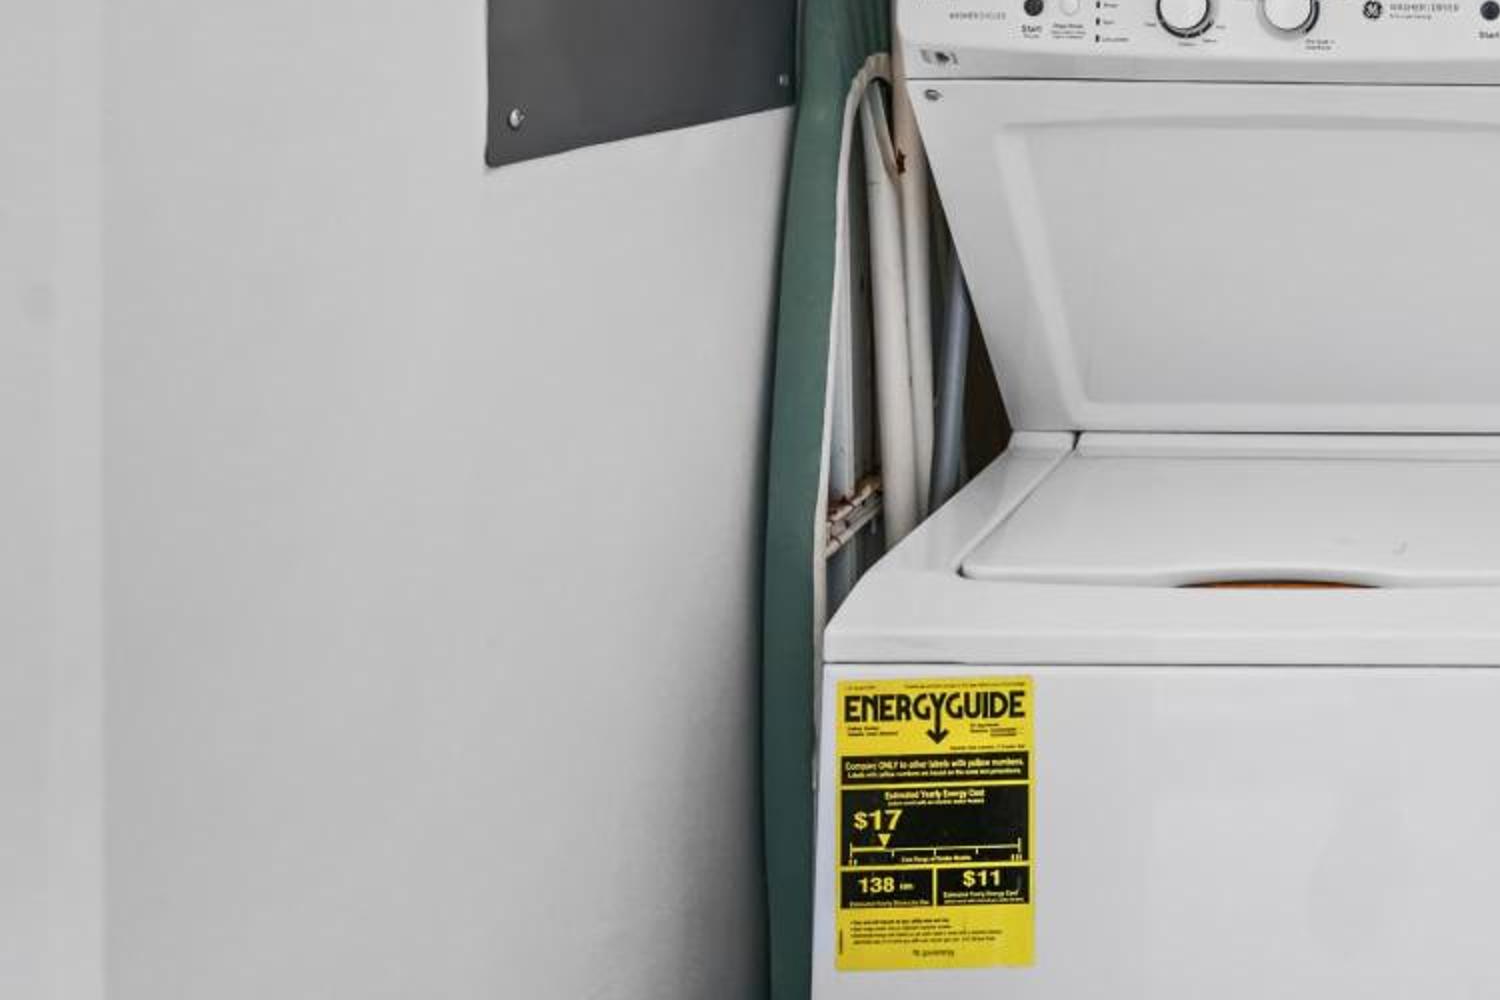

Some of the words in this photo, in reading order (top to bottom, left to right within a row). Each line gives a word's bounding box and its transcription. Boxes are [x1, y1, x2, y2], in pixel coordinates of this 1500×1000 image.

[1021, 24, 1042, 34] Start
[1478, 30, 1500, 40] Start
[843, 690, 1025, 723] ENERGYGUIDE
[878, 761, 898, 770] ONLY
[909, 760, 927, 769] other
[884, 790, 919, 801] Estimated
[921, 790, 941, 801] Yearly
[943, 789, 967, 801] Energy
[853, 809, 903, 831] $17
[859, 876, 895, 893] 138
[962, 869, 1000, 888] $11
